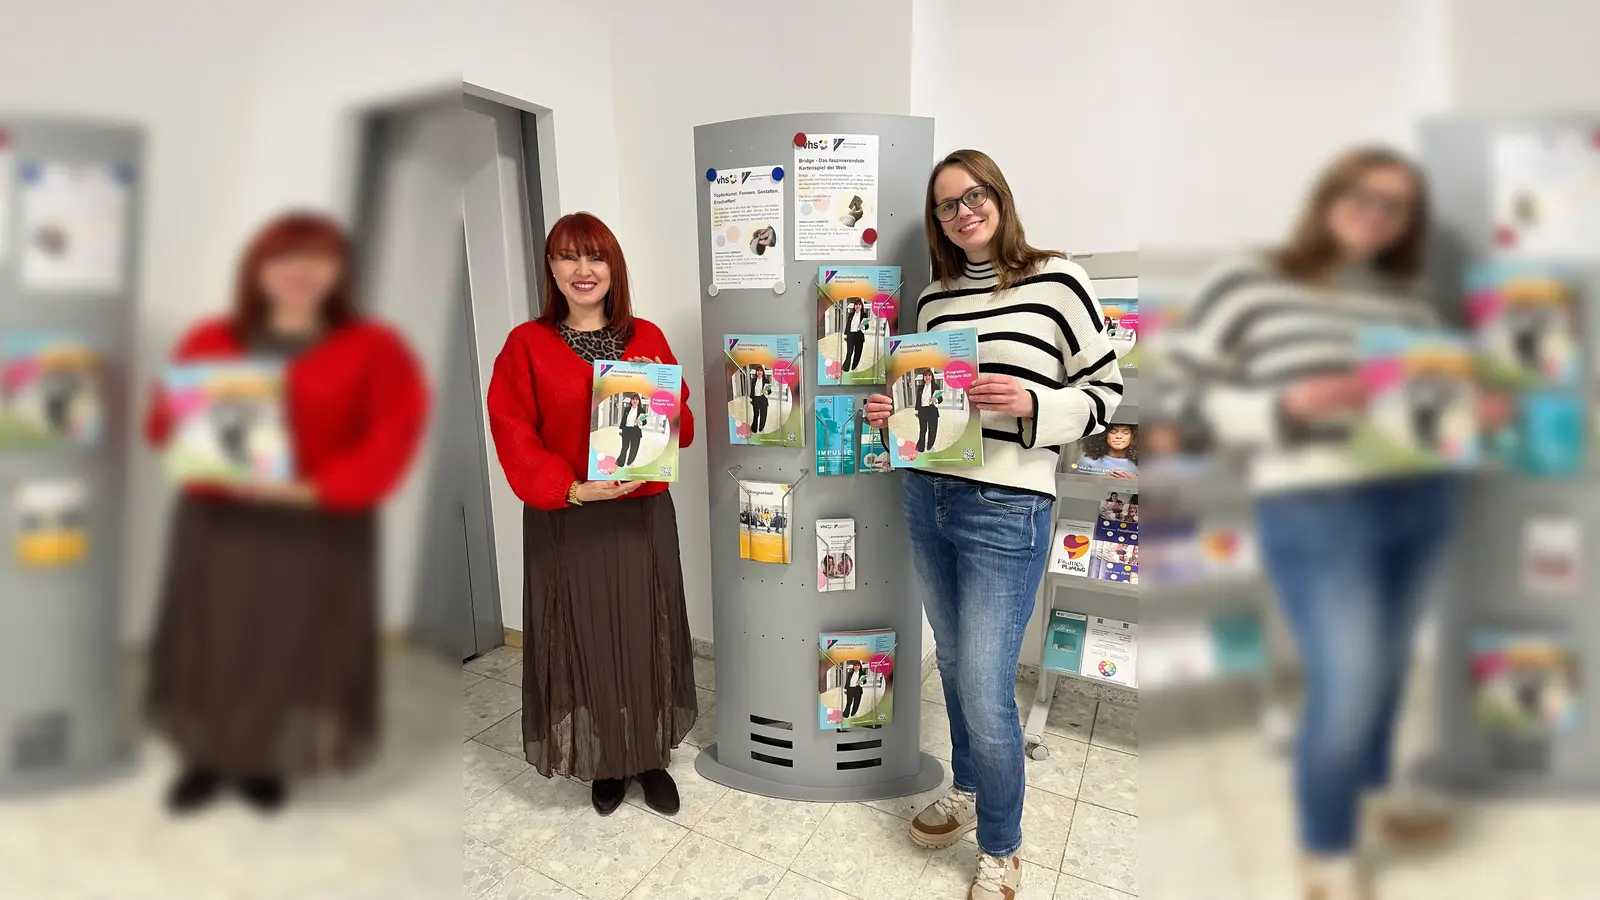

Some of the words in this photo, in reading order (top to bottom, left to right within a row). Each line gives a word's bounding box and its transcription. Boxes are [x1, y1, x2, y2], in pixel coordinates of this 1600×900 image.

[803, 140, 818, 149] vhs
[716, 175, 730, 185] vhs
[899, 341, 938, 349] Kreisvolkshochschule
